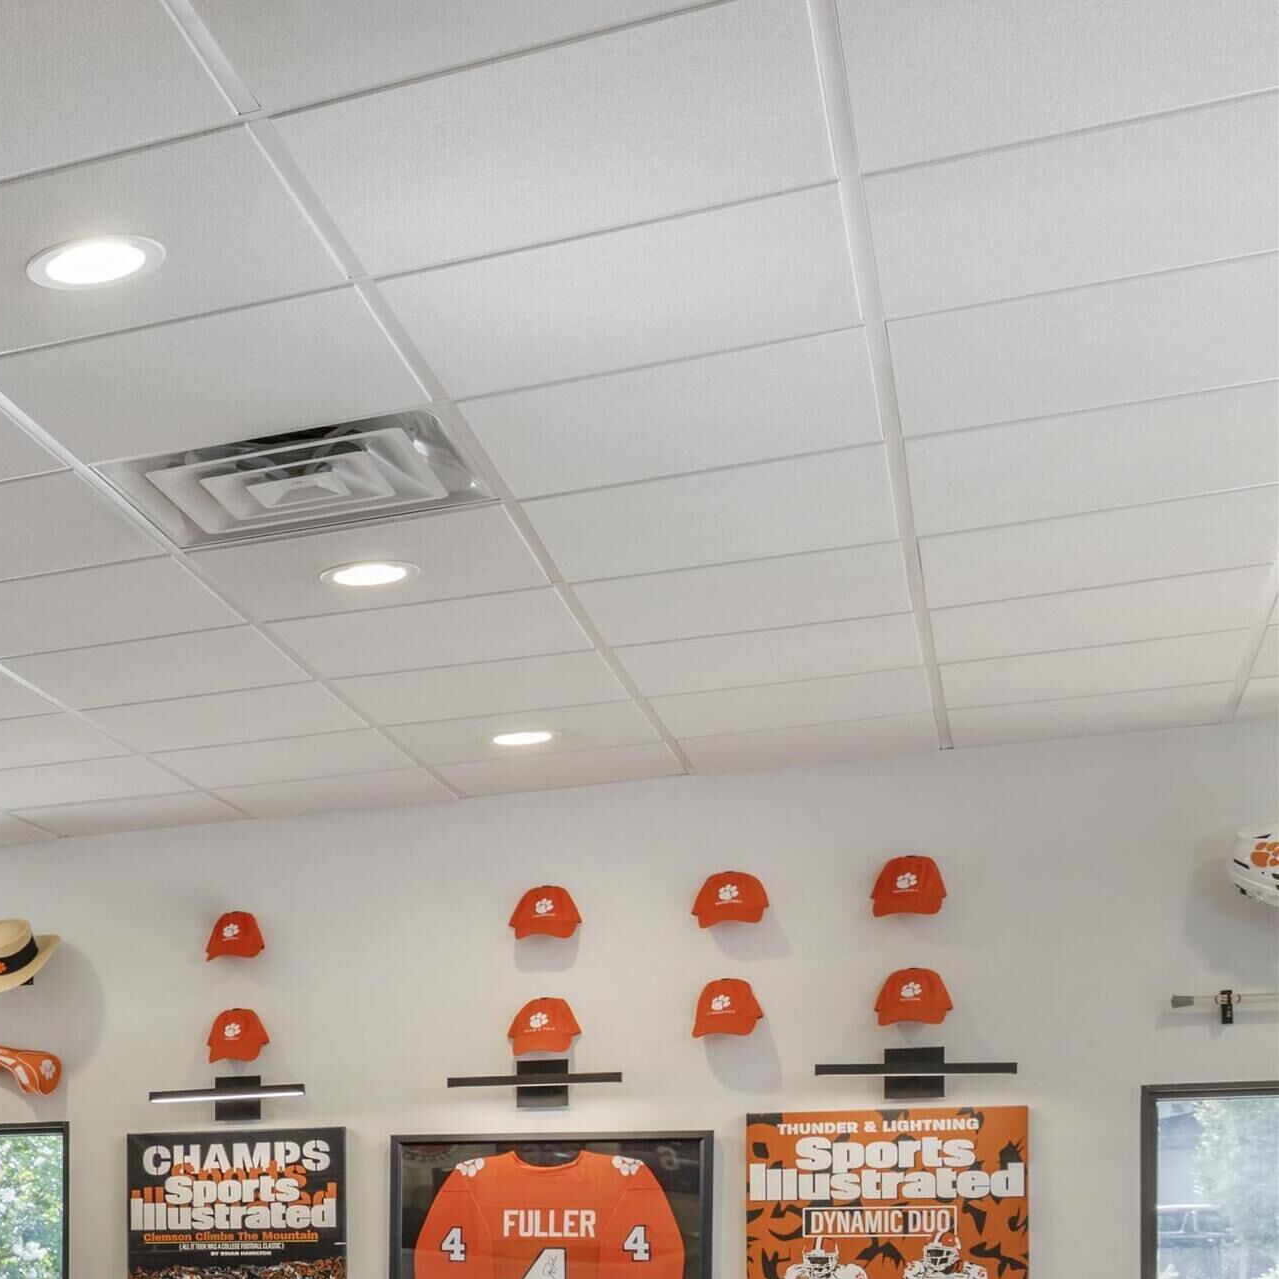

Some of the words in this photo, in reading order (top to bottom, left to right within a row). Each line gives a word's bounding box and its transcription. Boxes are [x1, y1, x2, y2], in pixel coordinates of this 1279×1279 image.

[777, 1122, 859, 1135] THUNDER
[864, 1121, 878, 1132] &
[882, 1117, 980, 1132] LIGHTNING
[143, 1140, 331, 1176] CHAMPS
[795, 1136, 976, 1173] Sports
[165, 1175, 300, 1207] Sports
[749, 1161, 1025, 1200] Illustrated
[130, 1197, 337, 1231] Illustrated
[503, 1209, 597, 1238] FULLER
[810, 1210, 904, 1234] DYNAMIC
[907, 1209, 951, 1233] DUO
[144, 1231, 192, 1242] Clemson
[195, 1231, 235, 1241] Climbs
[238, 1231, 260, 1241] The
[262, 1230, 319, 1241] Mountain
[440, 1226, 466, 1262] 4
[622, 1225, 651, 1262] 4
